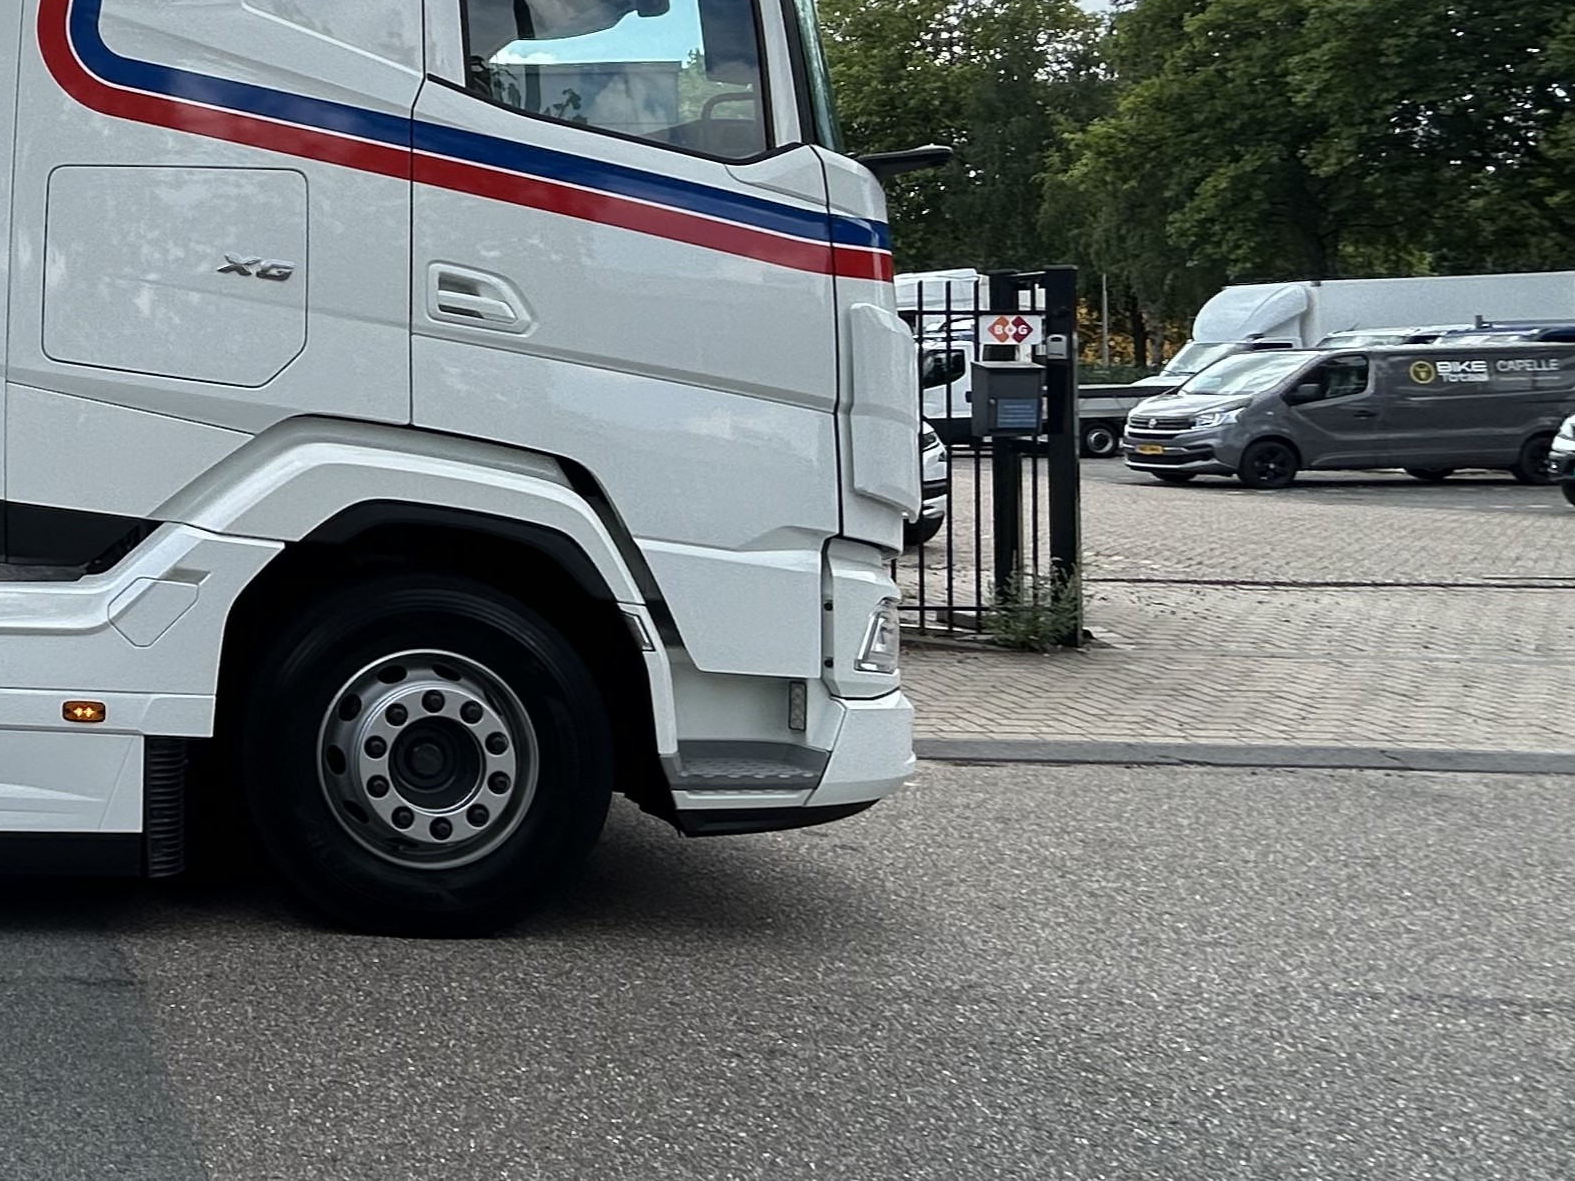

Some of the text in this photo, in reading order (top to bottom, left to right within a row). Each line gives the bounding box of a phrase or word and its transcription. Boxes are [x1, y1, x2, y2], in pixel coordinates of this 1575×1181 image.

[216, 252, 295, 281] XG
[1436, 359, 1560, 372] BIKE CAPELLE
